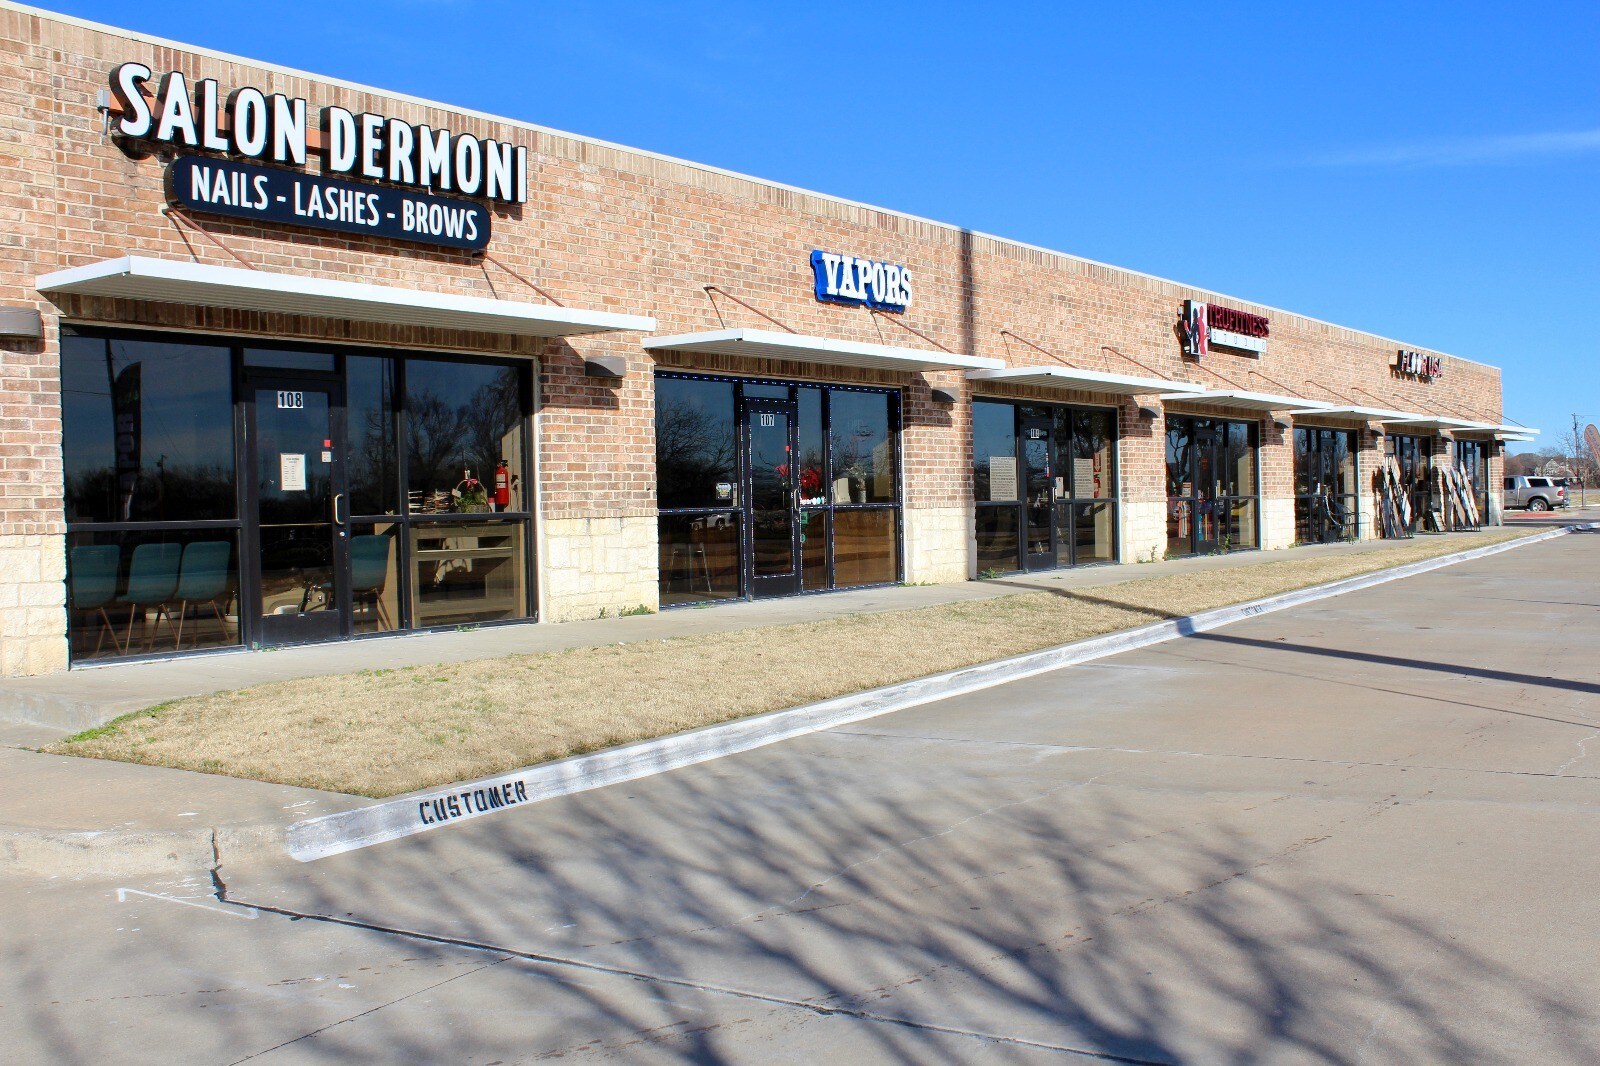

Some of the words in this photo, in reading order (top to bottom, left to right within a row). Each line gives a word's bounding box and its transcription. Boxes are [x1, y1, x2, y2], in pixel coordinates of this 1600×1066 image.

[117, 61, 307, 165] SALON
[330, 106, 528, 203] DERMONI
[191, 165, 268, 210] NAILS
[276, 194, 287, 203] -
[294, 175, 379, 227] LASHES
[386, 211, 395, 220] -
[403, 204, 478, 241] BROWS
[821, 252, 913, 307] VAPORS
[279, 391, 302, 407] 108
[761, 414, 773, 426] 107
[419, 780, 528, 825] CUSTOMER
